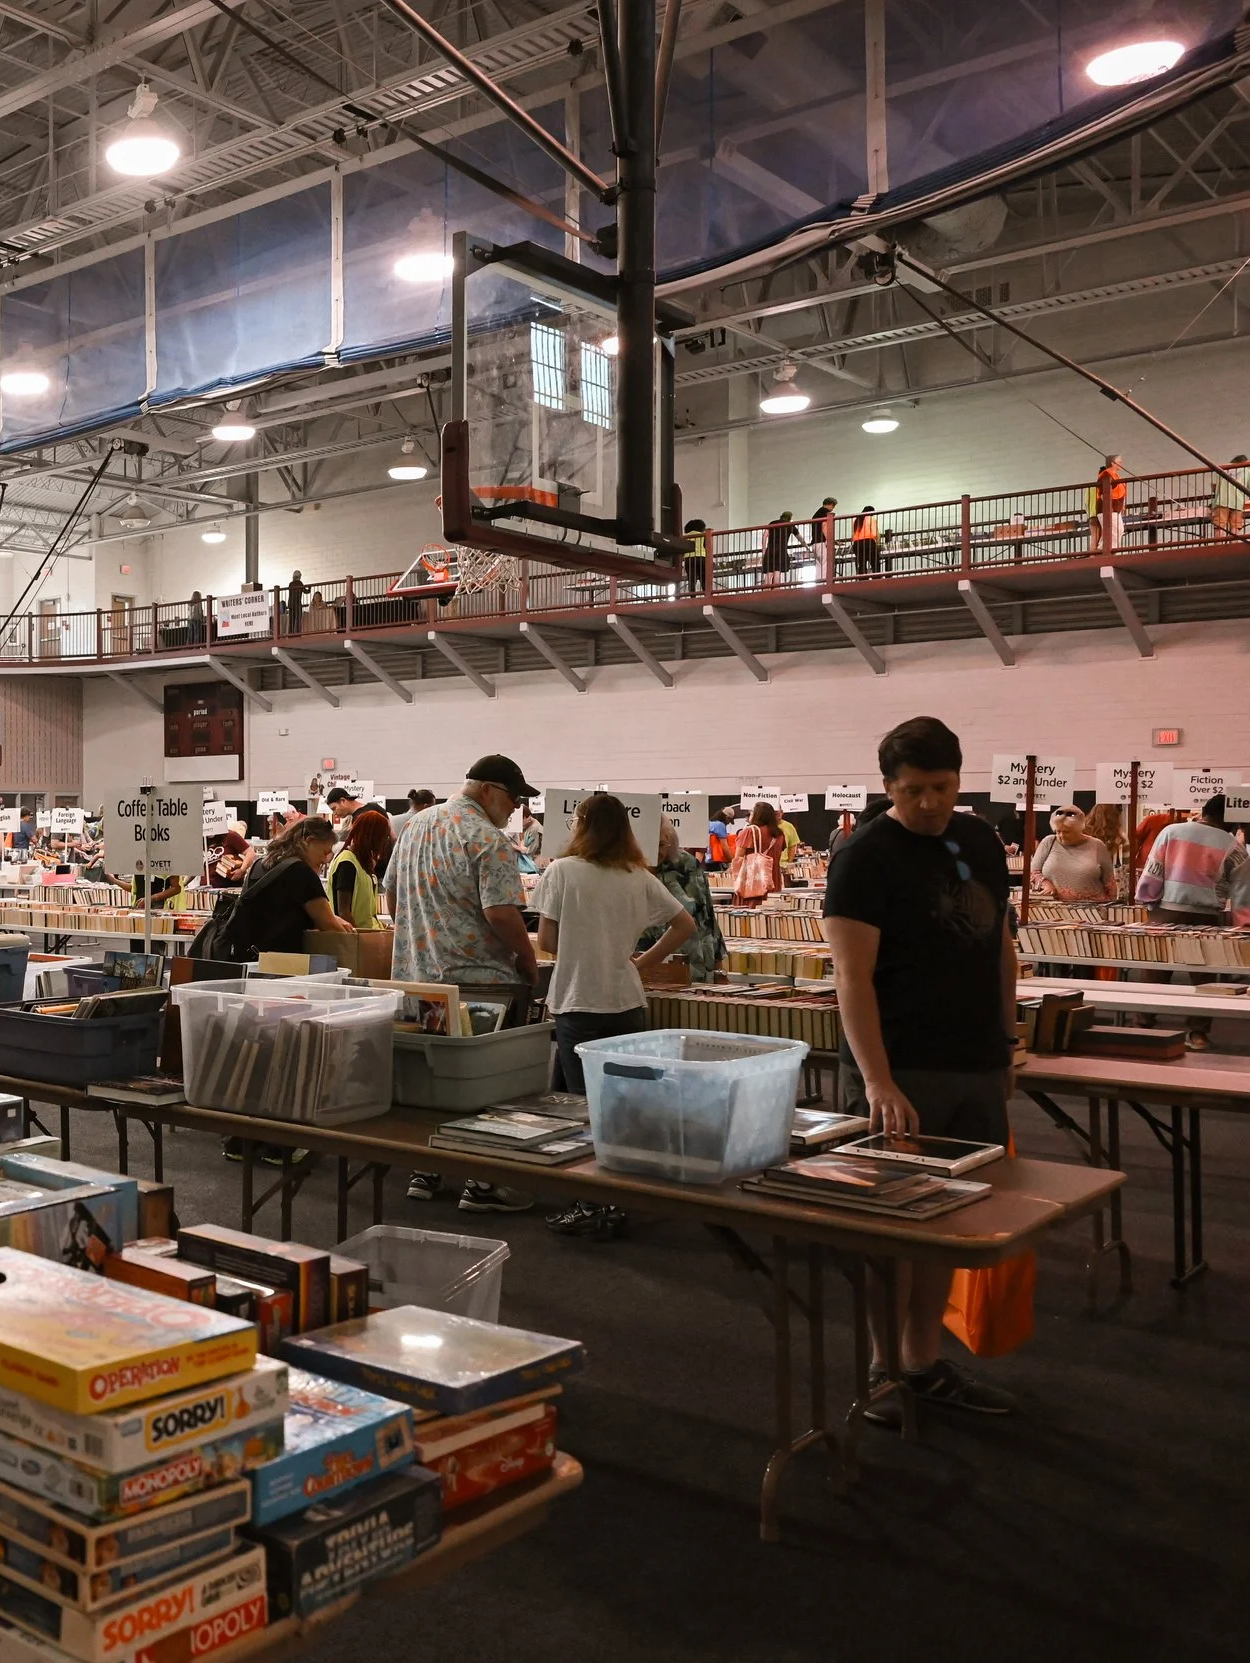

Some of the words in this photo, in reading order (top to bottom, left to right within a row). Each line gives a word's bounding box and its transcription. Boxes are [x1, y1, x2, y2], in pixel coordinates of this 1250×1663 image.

[244, 594, 265, 605] CORNER
[193, 707, 208, 717] period
[1158, 731, 1177, 743] EXIT
[1011, 763, 1055, 776] Mytery
[1113, 768, 1155, 779] Mysery
[330, 773, 351, 783] Vintage
[997, 775, 1010, 785] $2
[1034, 777, 1067, 788] Under
[1190, 775, 1224, 785] Fiction
[344, 784, 365, 794] Mystery
[1141, 780, 1153, 789] $2
[1189, 786, 1210, 794] Over
[1212, 785, 1224, 795] $2
[156, 798, 188, 817] Table
[202, 806, 215, 816] tery
[662, 802, 691, 813] rback
[58, 811, 75, 819] Foreign
[205, 816, 223, 824] Under
[55, 817, 77, 825] Language
[150, 860, 172, 868] OYETT
[88, 1355, 181, 1402] OPERATION
[151, 1395, 225, 1443] SORRY!
[122, 1456, 202, 1500] MONOPOLY
[103, 1584, 195, 1652] SORRY!
[190, 1599, 264, 1654] OPOLY
